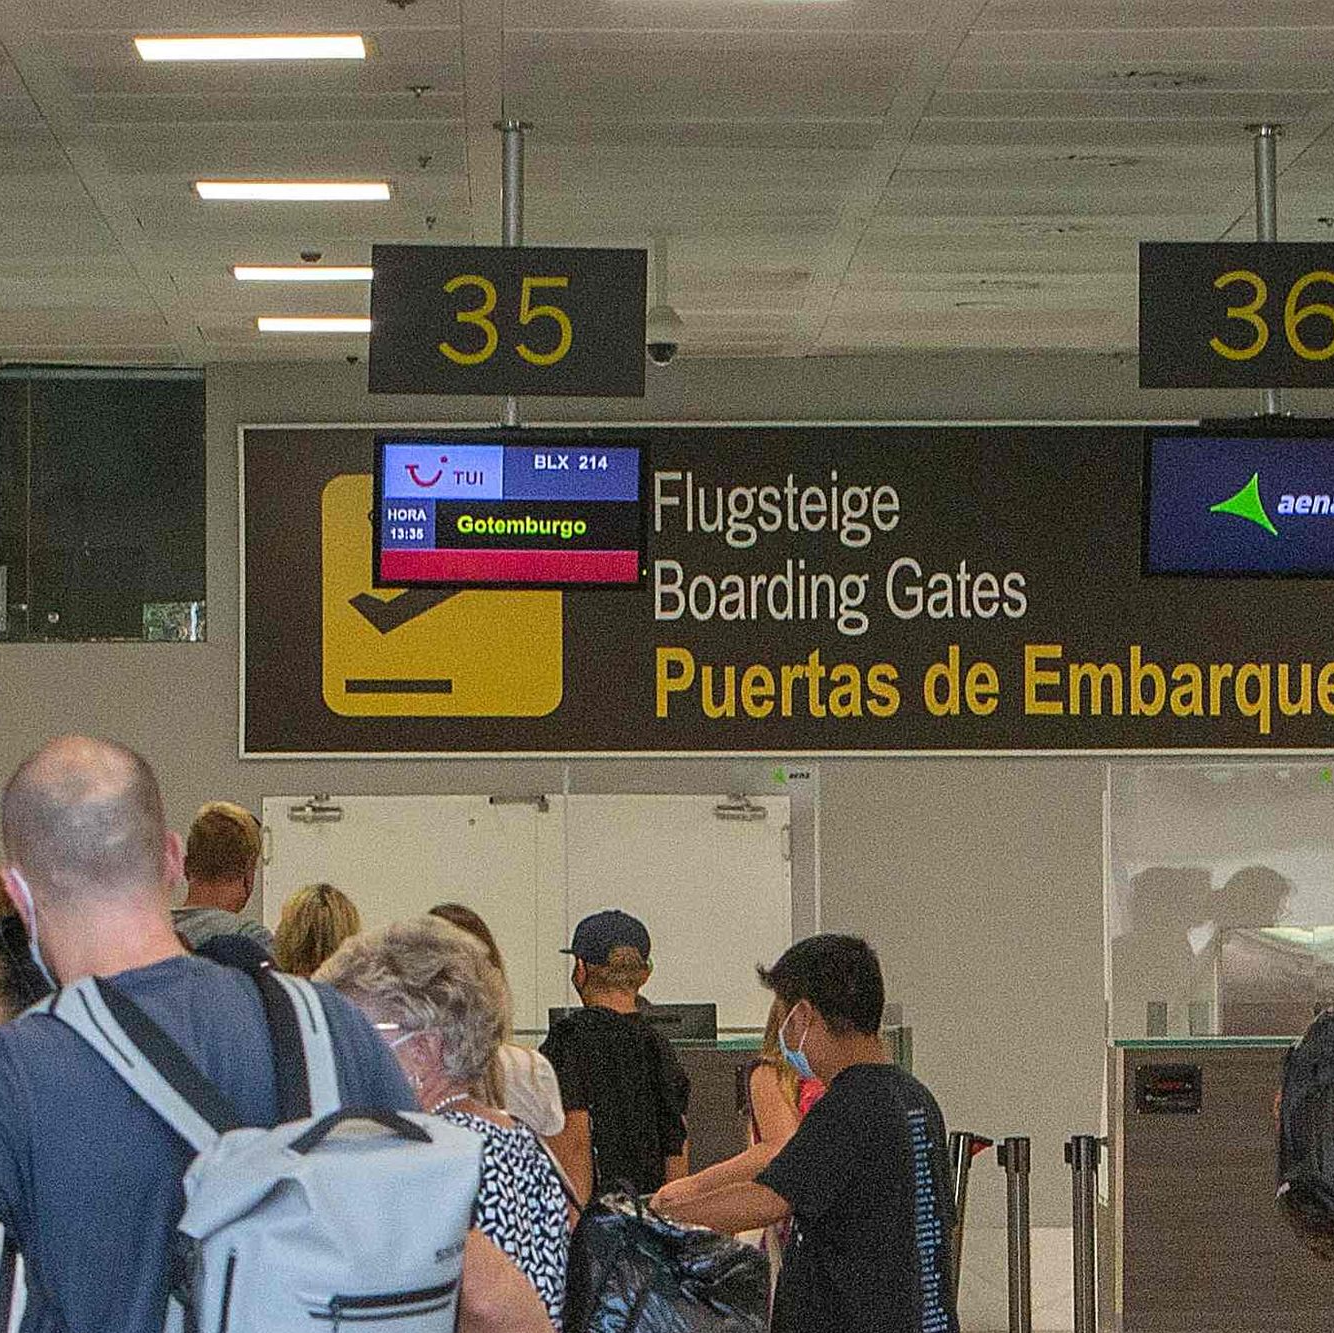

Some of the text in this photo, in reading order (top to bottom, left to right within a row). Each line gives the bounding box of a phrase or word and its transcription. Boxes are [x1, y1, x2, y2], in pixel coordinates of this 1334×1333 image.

[437, 275, 573, 366] 35
[453, 471, 484, 485] TUI
[534, 454, 608, 470] BLX 214
[387, 508, 427, 522] HORA
[456, 515, 587, 538] Gotemburgo
[653, 470, 900, 549] Flugsteige
[653, 556, 1028, 636] Boarding Gates
[655, 646, 900, 718] Puertas
[923, 645, 1000, 716] de
